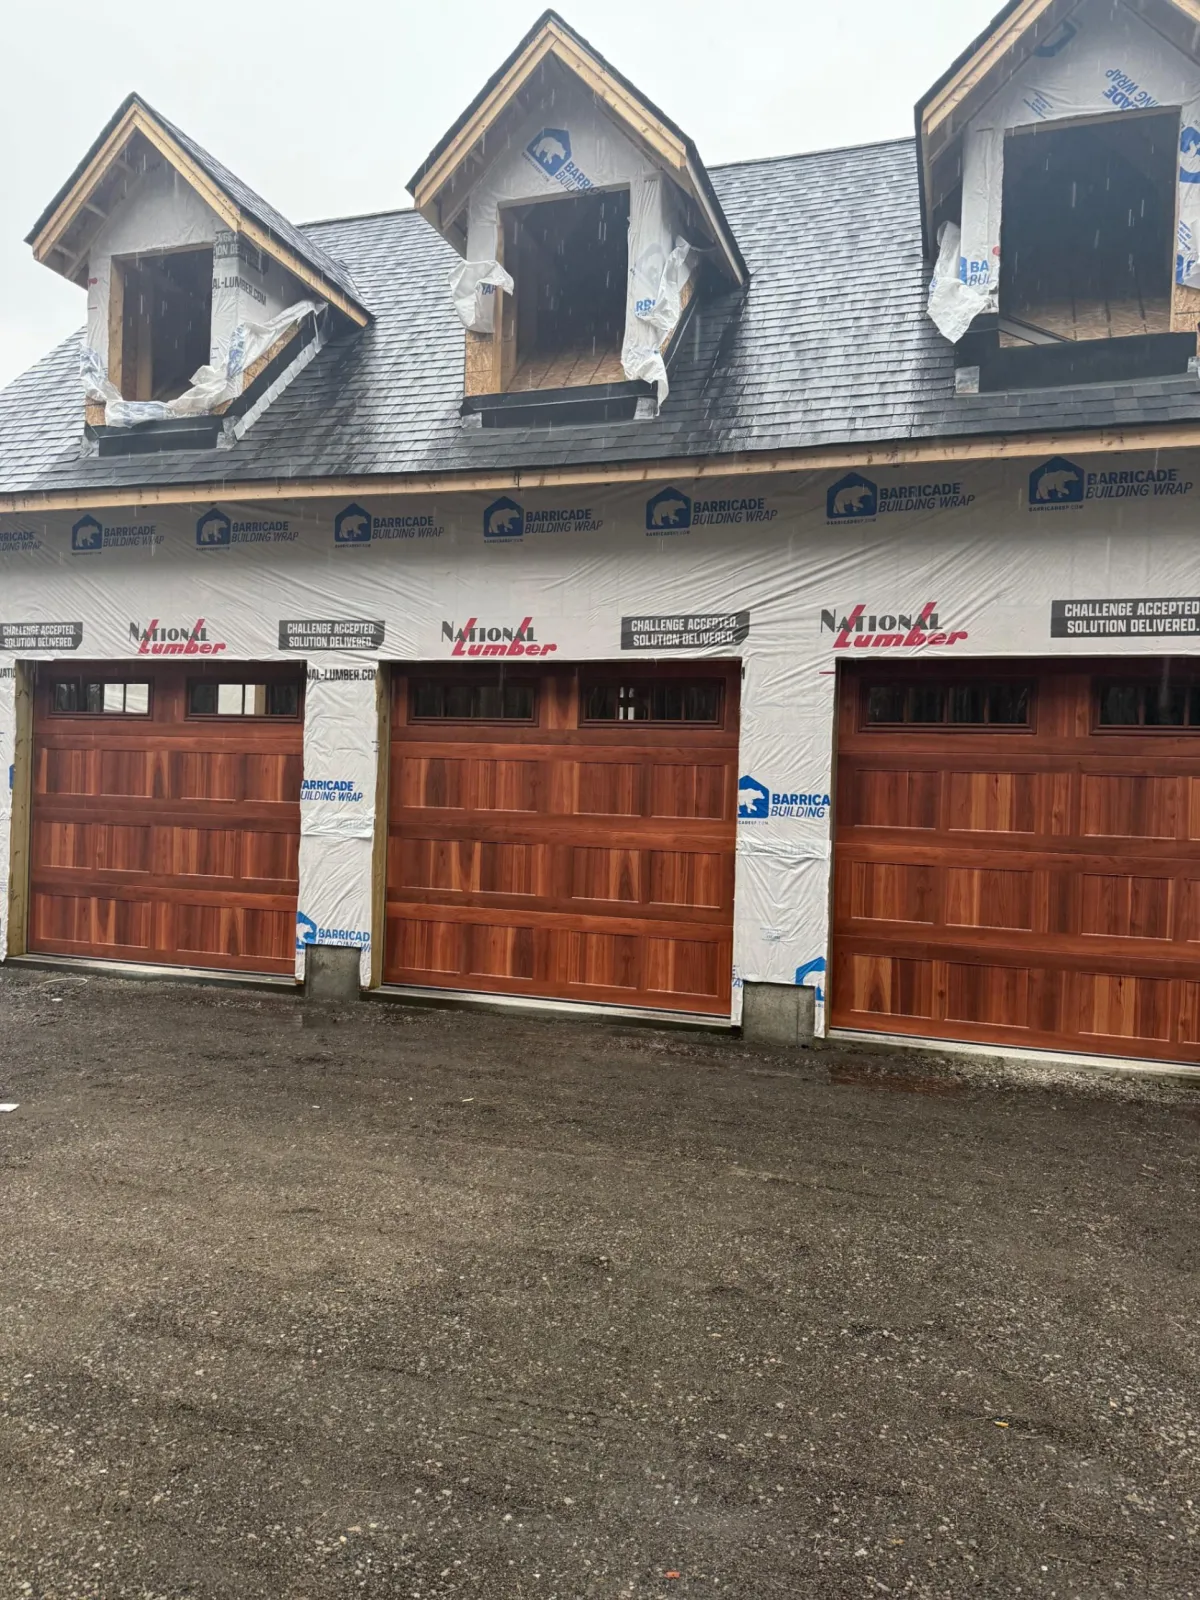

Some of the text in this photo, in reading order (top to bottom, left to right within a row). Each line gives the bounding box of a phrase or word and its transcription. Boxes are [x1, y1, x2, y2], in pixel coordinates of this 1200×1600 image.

[1104, 69, 1139, 96] WRAP
[1087, 468, 1177, 486] BARRICADE
[880, 482, 961, 500] BARRICADE
[1085, 481, 1193, 499] BUILDING WRAP
[693, 497, 765, 513] BARRICADE
[878, 494, 975, 513] BUILDING WRAP
[373, 516, 434, 528] BARRICADE
[526, 508, 592, 522] BARRICADE
[692, 509, 778, 525] BUILDING WRAP
[104, 525, 157, 537] BARRICADE
[232, 521, 289, 532] BARRICADE
[372, 526, 444, 540] BUILDING WRAP
[525, 519, 603, 534] BUILDING WRAP
[103, 535, 164, 548] BUILDING WRAP
[231, 531, 298, 543] BUILDING WRAP
[1064, 602, 1134, 617] CHALLENGE
[631, 618, 685, 632] CHALLENGE
[820, 608, 944, 634] NATIONAL
[833, 601, 969, 649] Lumber
[1067, 618, 1200, 634] SOLUTION DELIVERED.
[2, 625, 40, 636] CHALLENGE
[129, 620, 209, 642] NATIONAL
[287, 623, 332, 635] CHALLENGE
[441, 620, 538, 643] NATIONAL
[4, 637, 36, 648] SOLUTION
[138, 618, 226, 655] Lumber
[288, 636, 328, 648] SOLUTION
[451, 617, 557, 656] Lumber
[633, 633, 680, 646] SOLUTION
[302, 780, 354, 792] ARRICADE
[300, 790, 364, 802] UILDING WRAP
[770, 806, 825, 818] BUILDING
